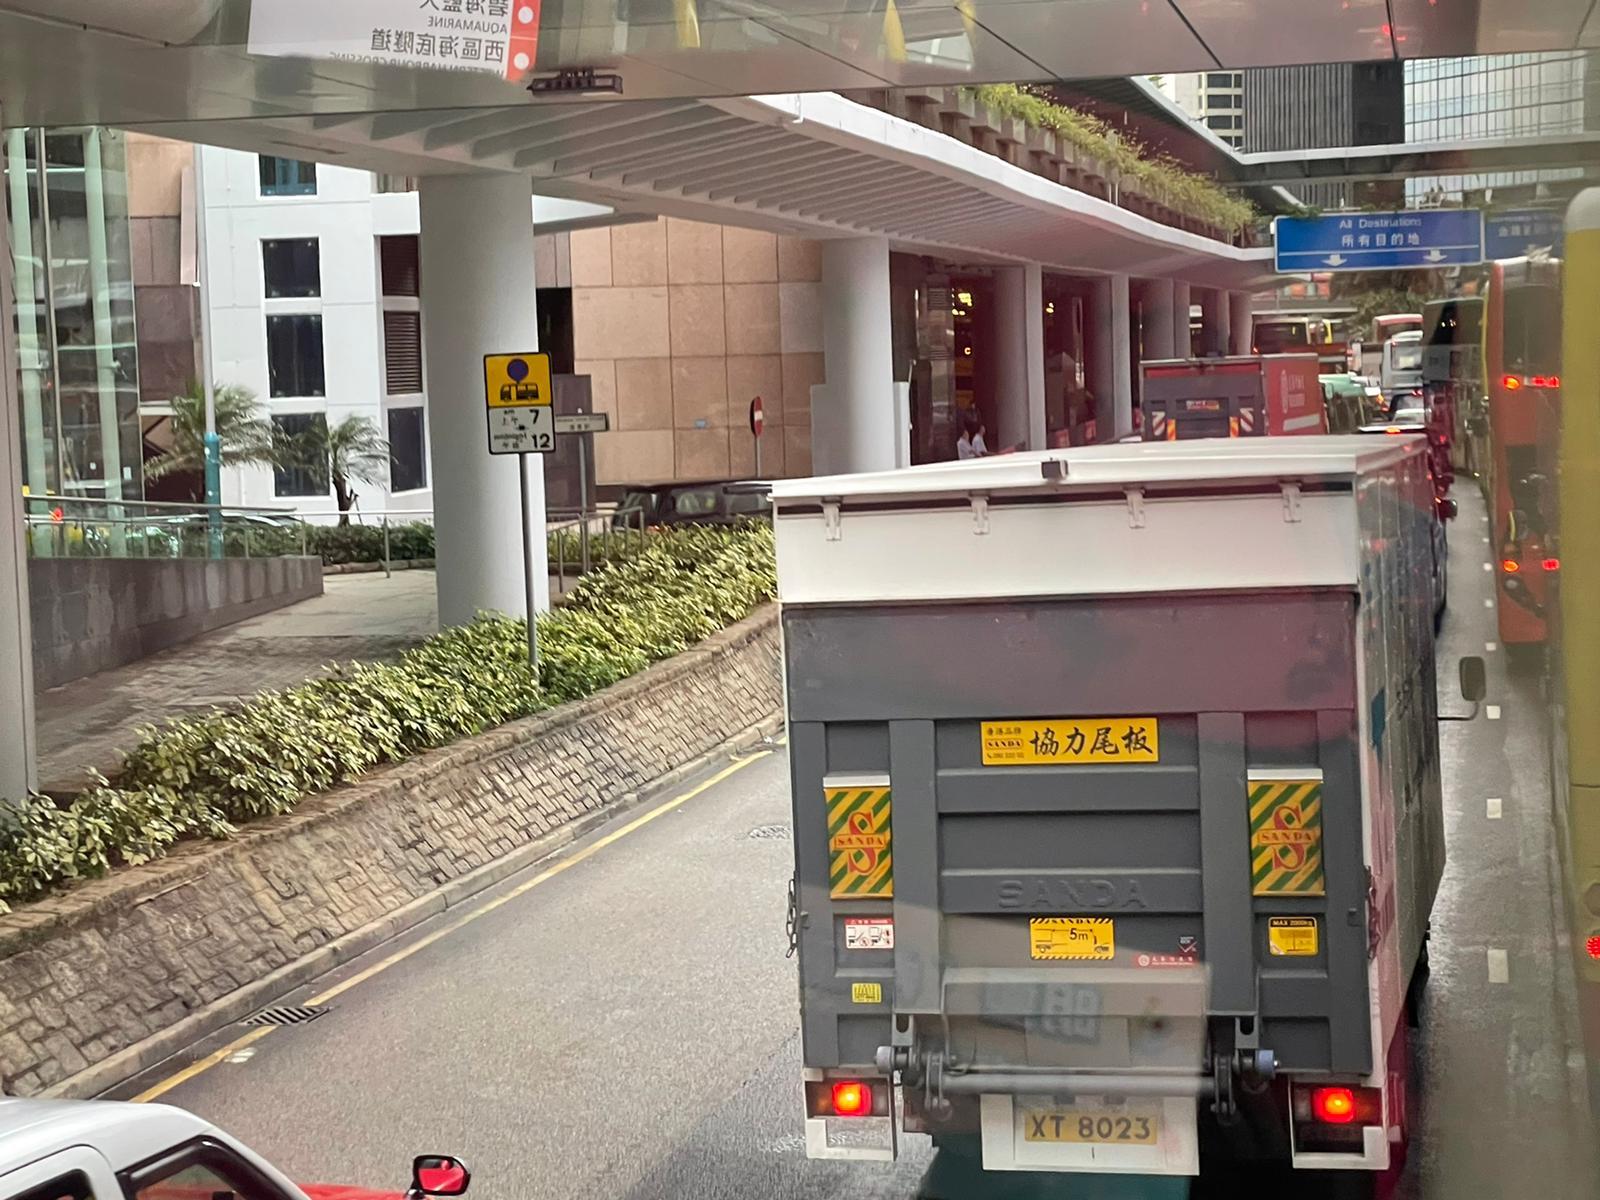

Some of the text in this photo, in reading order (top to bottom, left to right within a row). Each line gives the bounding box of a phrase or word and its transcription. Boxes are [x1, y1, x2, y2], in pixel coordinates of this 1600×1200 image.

[1340, 219, 1353, 230] All
[1342, 232, 1420, 249] 所有目的地
[529, 408, 540, 425] 7
[531, 433, 551, 449] 12
[987, 740, 1021, 748] SANDA
[1029, 725, 1154, 757] 協力尾板
[837, 836, 884, 847] SANDA
[1261, 831, 1313, 842] SANDA
[999, 879, 1147, 909] SANDA
[1070, 927, 1089, 941] 5m
[1031, 1114, 1151, 1140] XT 8023
